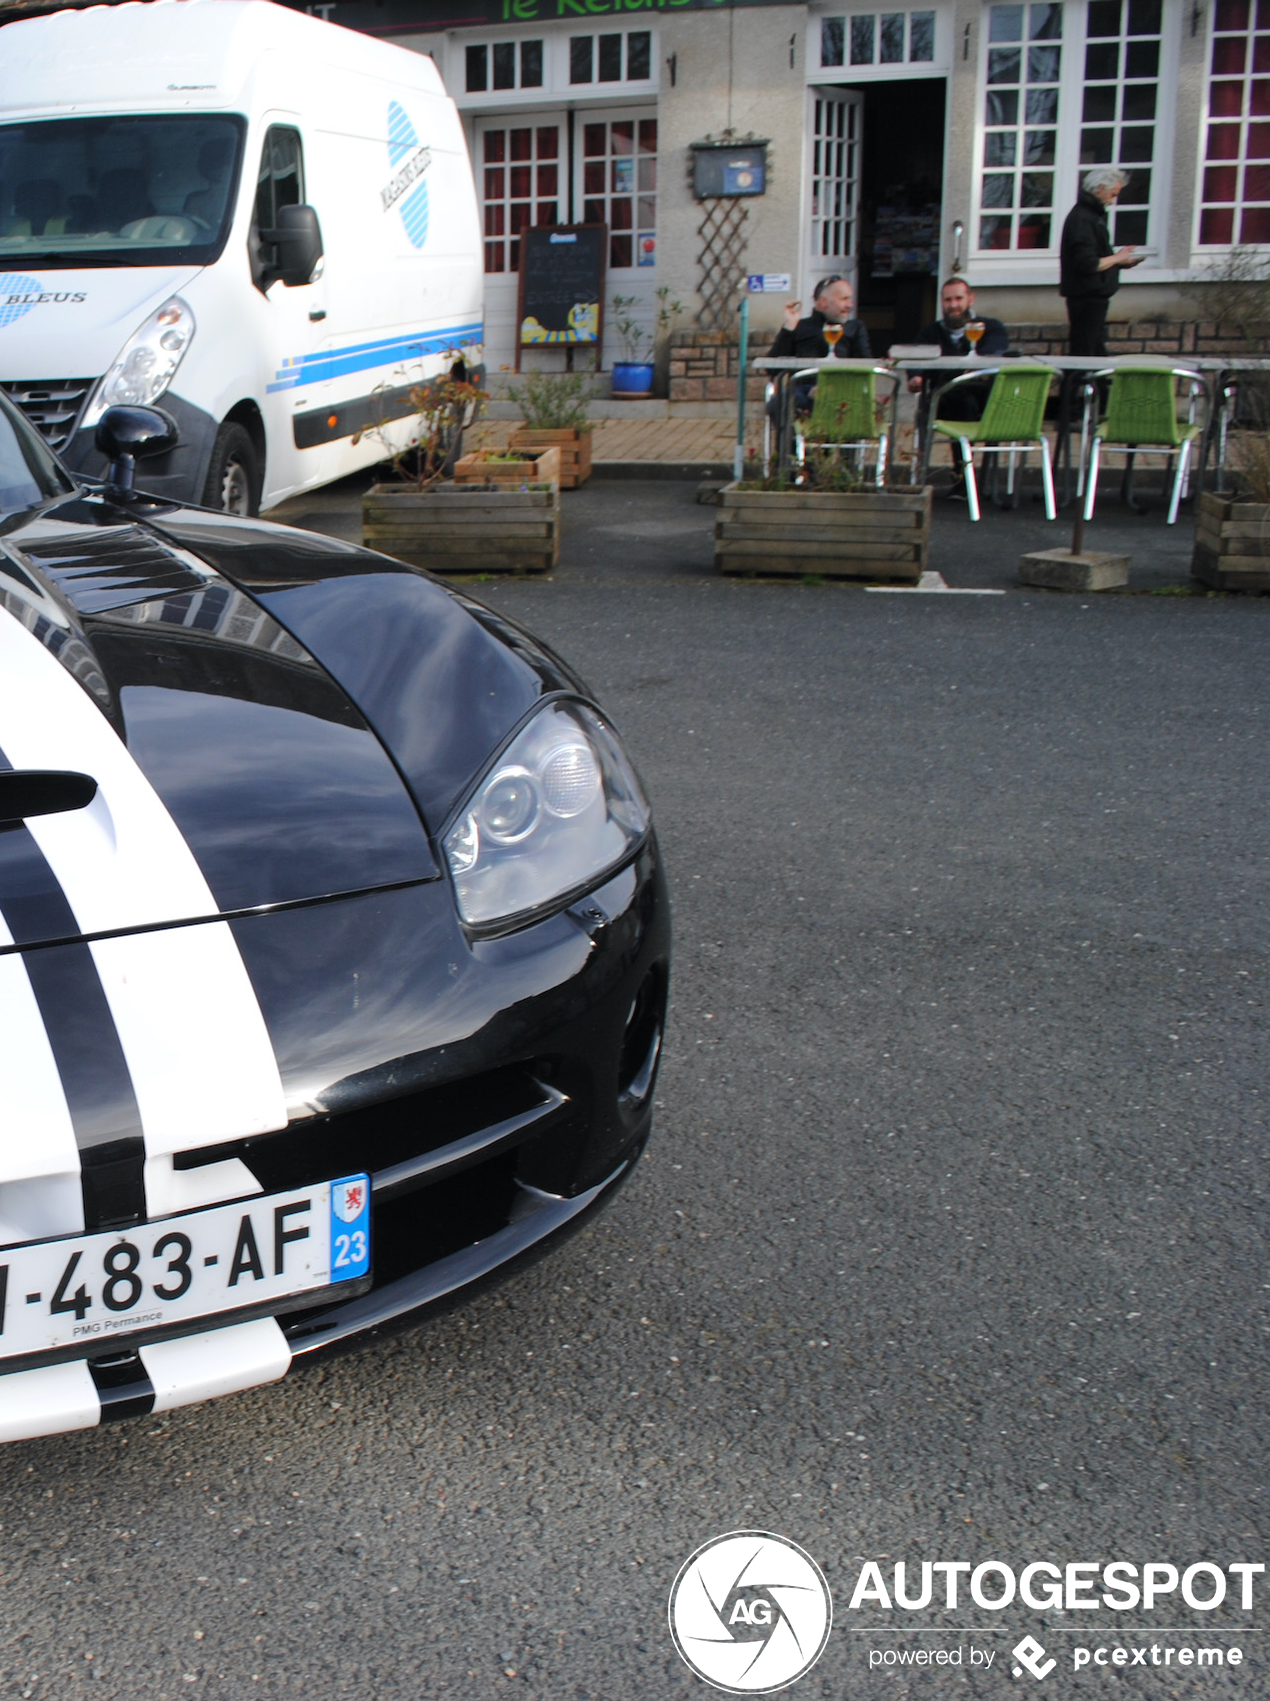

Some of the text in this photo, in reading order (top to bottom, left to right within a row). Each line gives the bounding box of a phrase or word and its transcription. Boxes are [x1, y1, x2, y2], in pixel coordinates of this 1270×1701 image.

[2, 292, 88, 305] BLEUS
[334, 1231, 367, 1268] 23
[73, 1311, 163, 1337] PMG Permance
